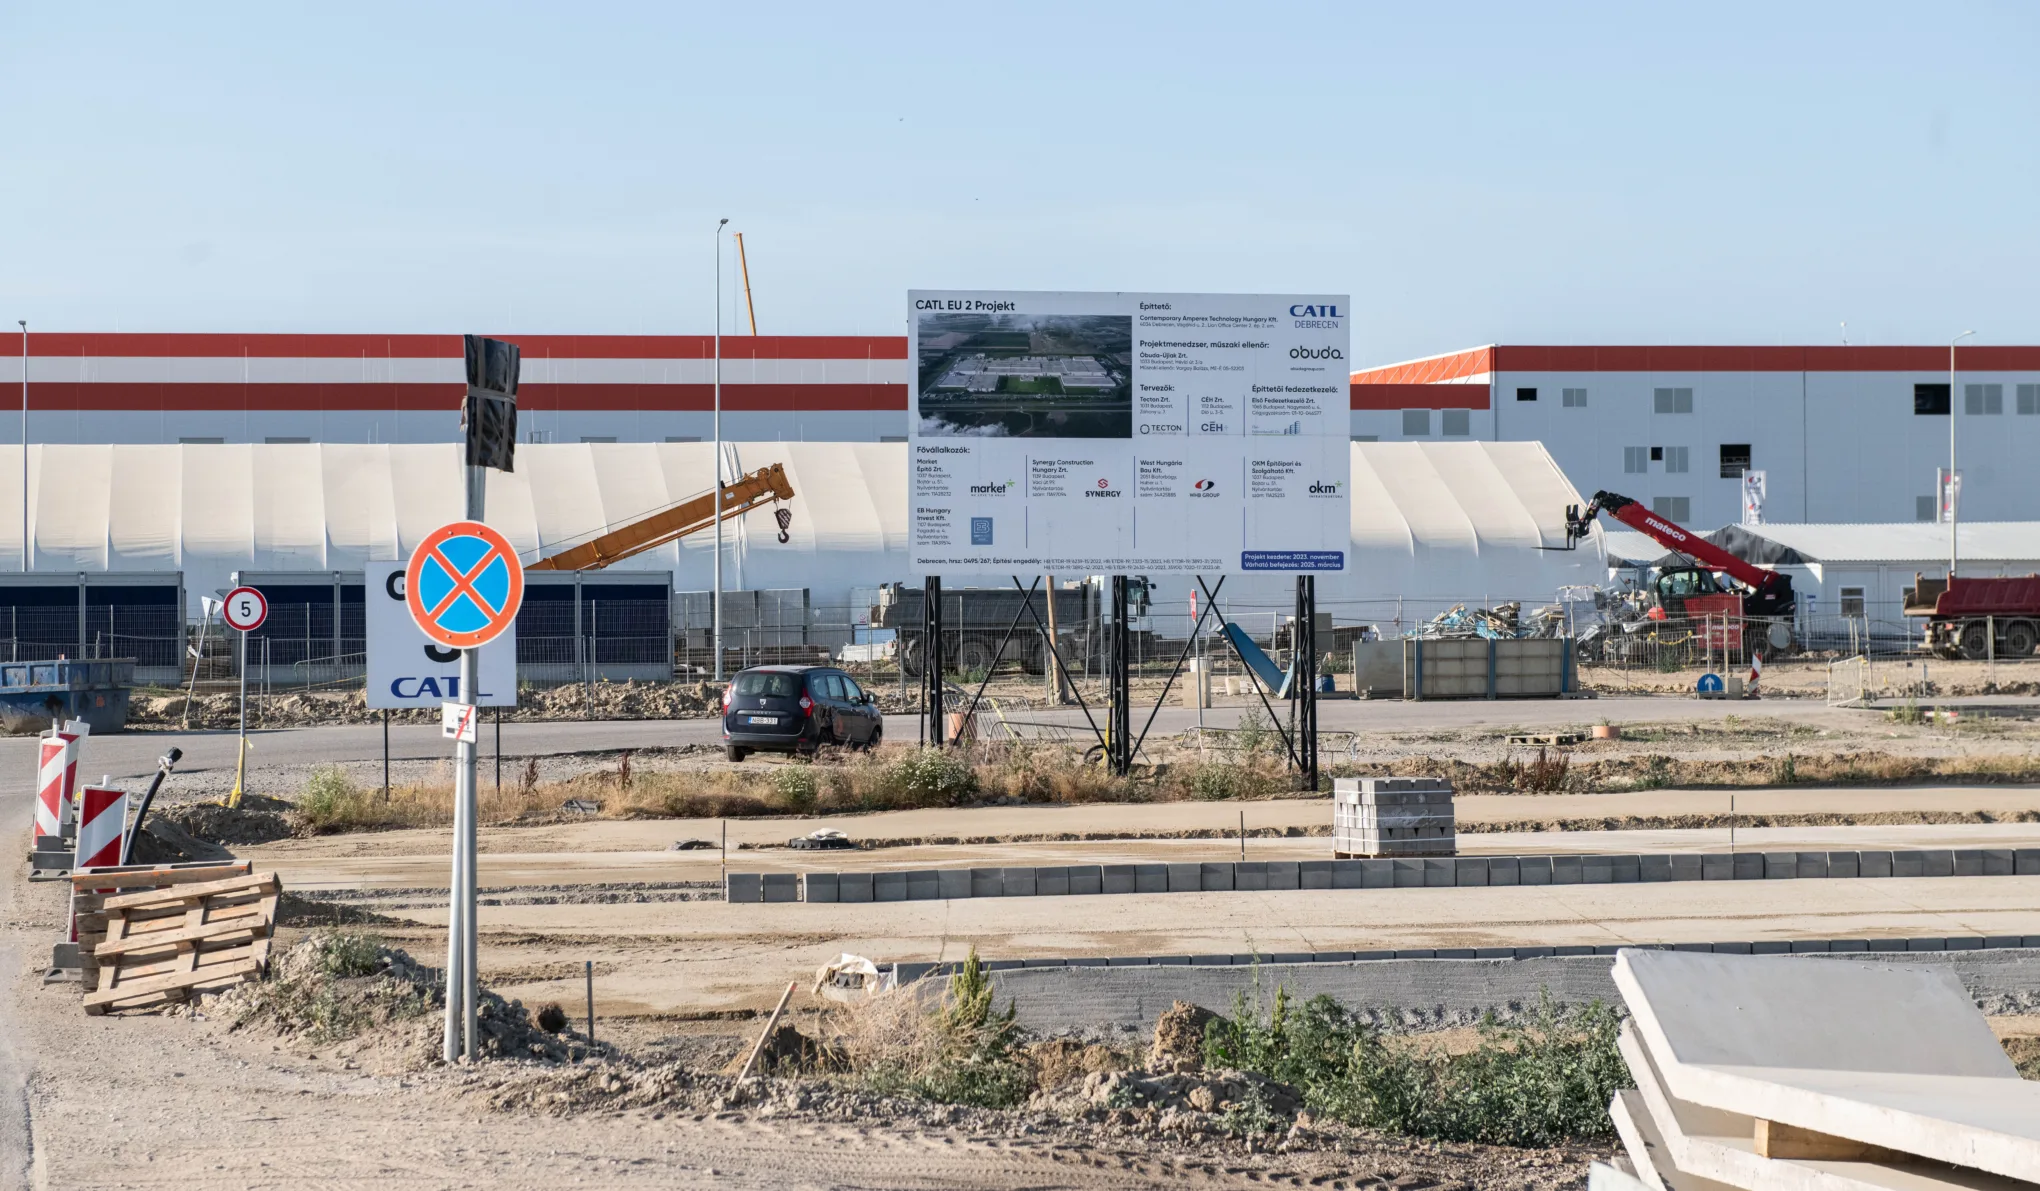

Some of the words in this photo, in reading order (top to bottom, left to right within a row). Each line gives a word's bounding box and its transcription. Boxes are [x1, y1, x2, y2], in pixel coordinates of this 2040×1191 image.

[916, 300, 944, 310] CATL
[948, 300, 962, 310] EU
[965, 300, 972, 310] 2
[975, 300, 1015, 312] Projekt
[1290, 305, 1344, 317] CATL
[1294, 320, 1339, 328] DEBRECEN
[1140, 340, 1209, 349] Projektmenedzser,
[970, 482, 1006, 493] market
[1309, 480, 1335, 494] okm
[1645, 517, 1686, 541] mateco
[241, 601, 251, 617] 5
